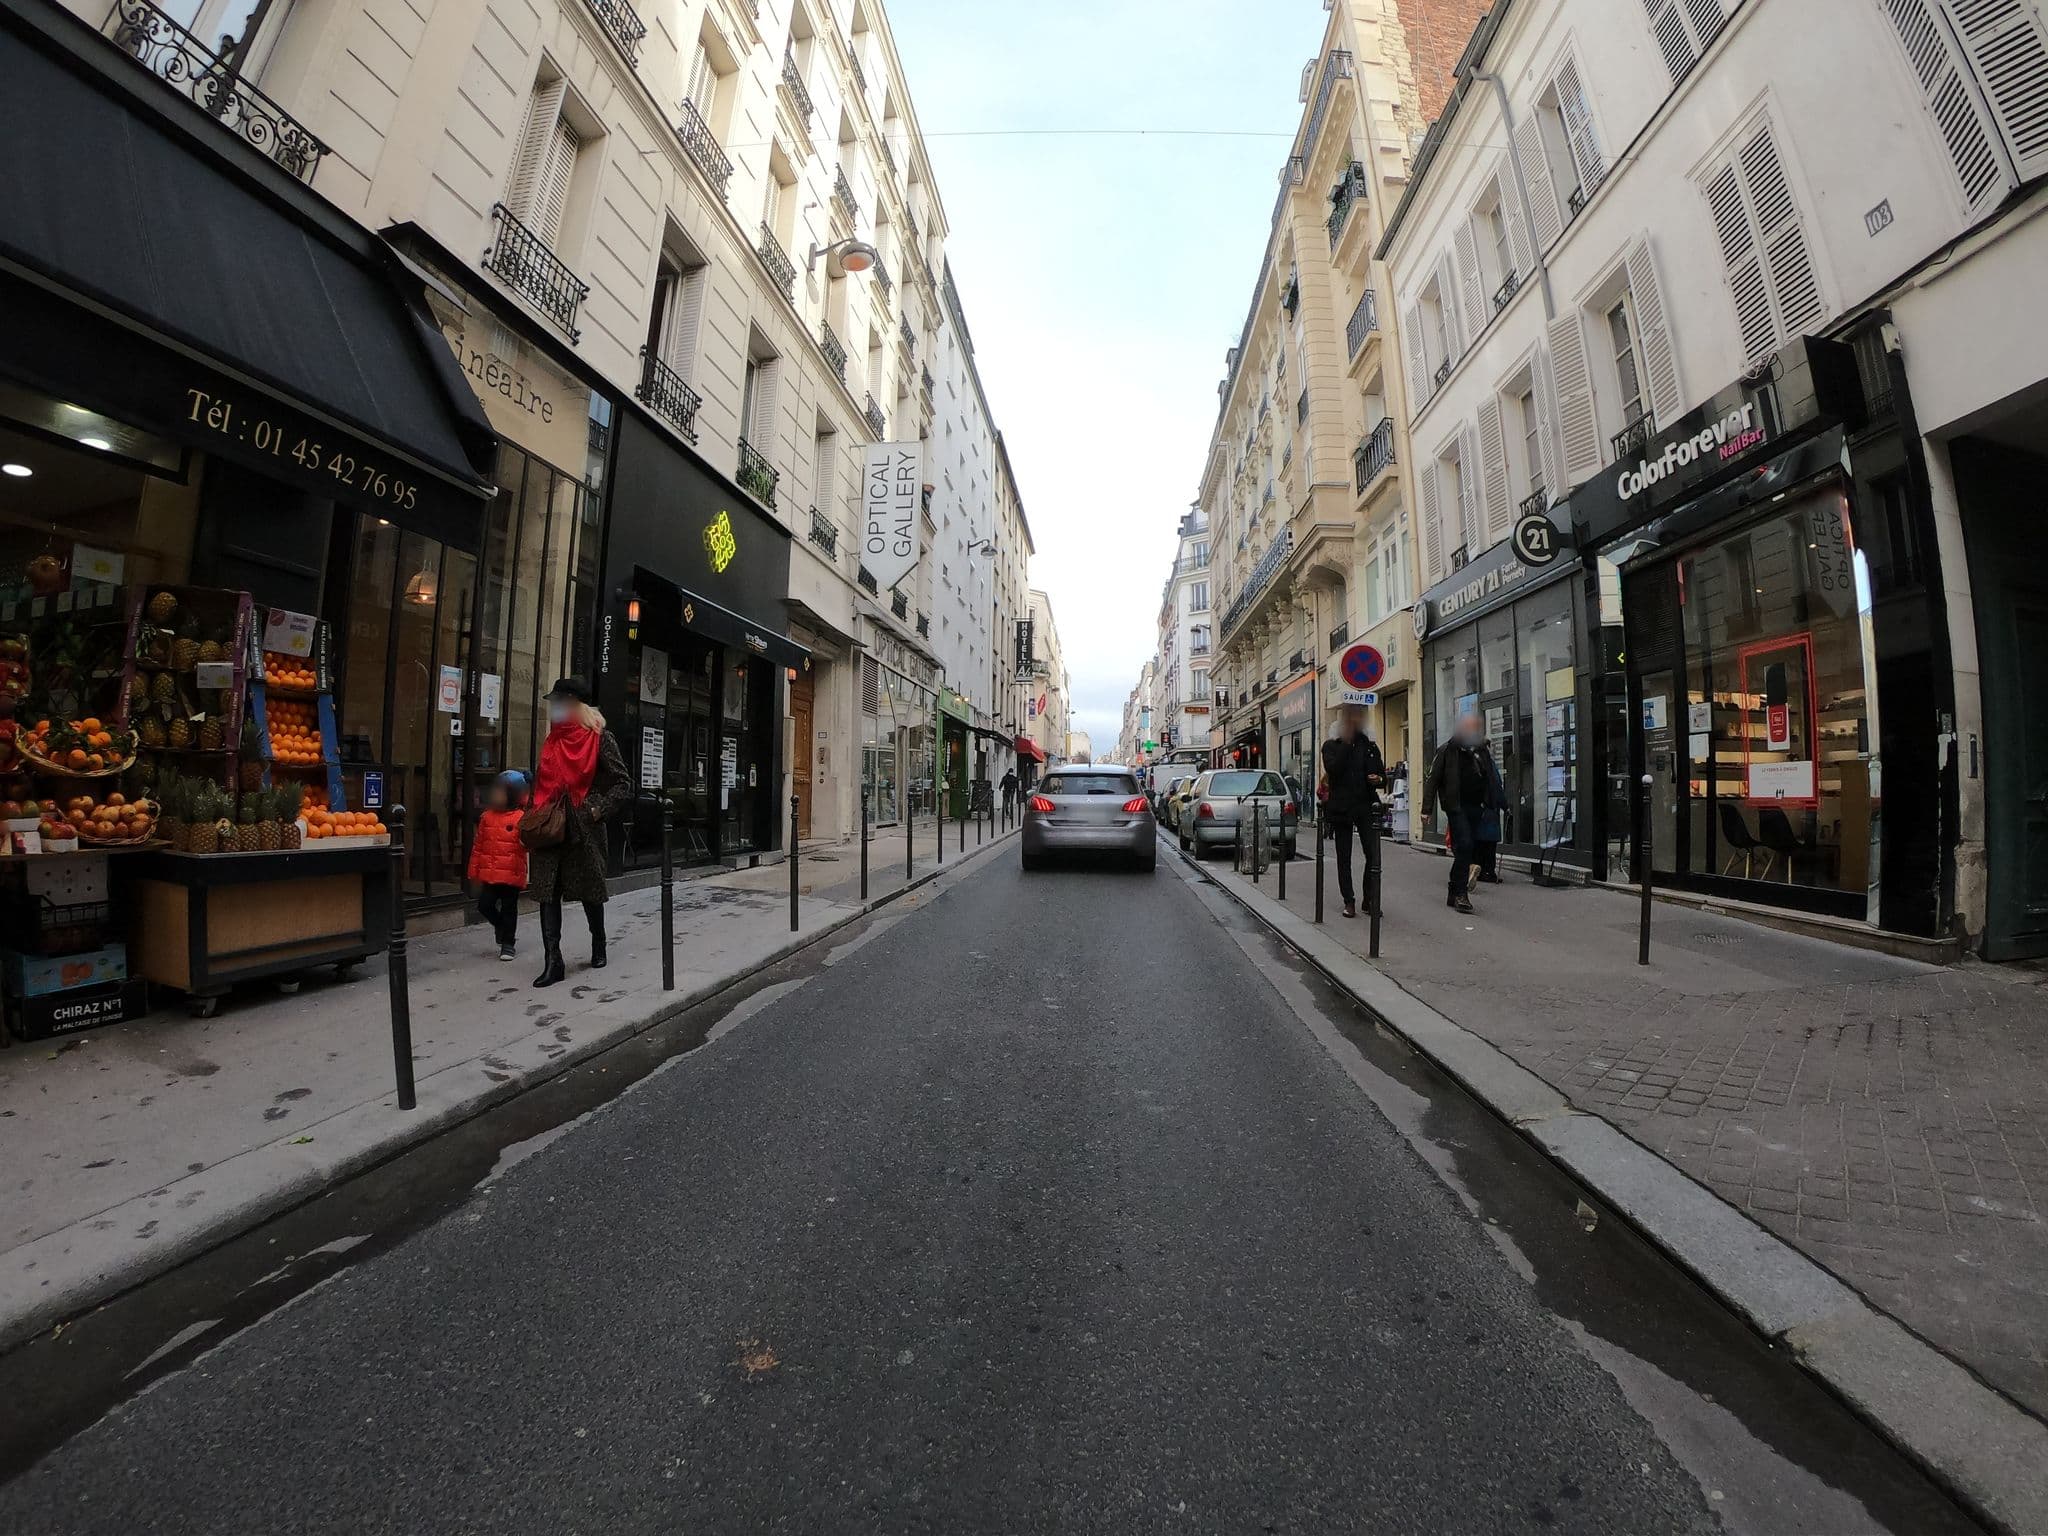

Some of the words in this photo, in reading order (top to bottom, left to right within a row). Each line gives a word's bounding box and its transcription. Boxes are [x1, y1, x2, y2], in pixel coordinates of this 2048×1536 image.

[1866, 204, 1891, 235] 103
[186, 387, 233, 434] Tél
[253, 419, 284, 457] 01
[290, 437, 323, 471] 45
[326, 452, 356, 486] 42
[360, 465, 390, 498] 76
[391, 479, 418, 511] 95
[1617, 401, 1753, 501] ColorForever
[866, 454, 890, 555] OPTICAL
[892, 450, 916, 558] GALLERY
[1439, 575, 1486, 618] CENTURY
[1486, 568, 1502, 594] 21
[600, 614, 613, 674] Coiffure
[1343, 693, 1365, 703] SAUF
[52, 1001, 101, 1021] CHIRAZ
